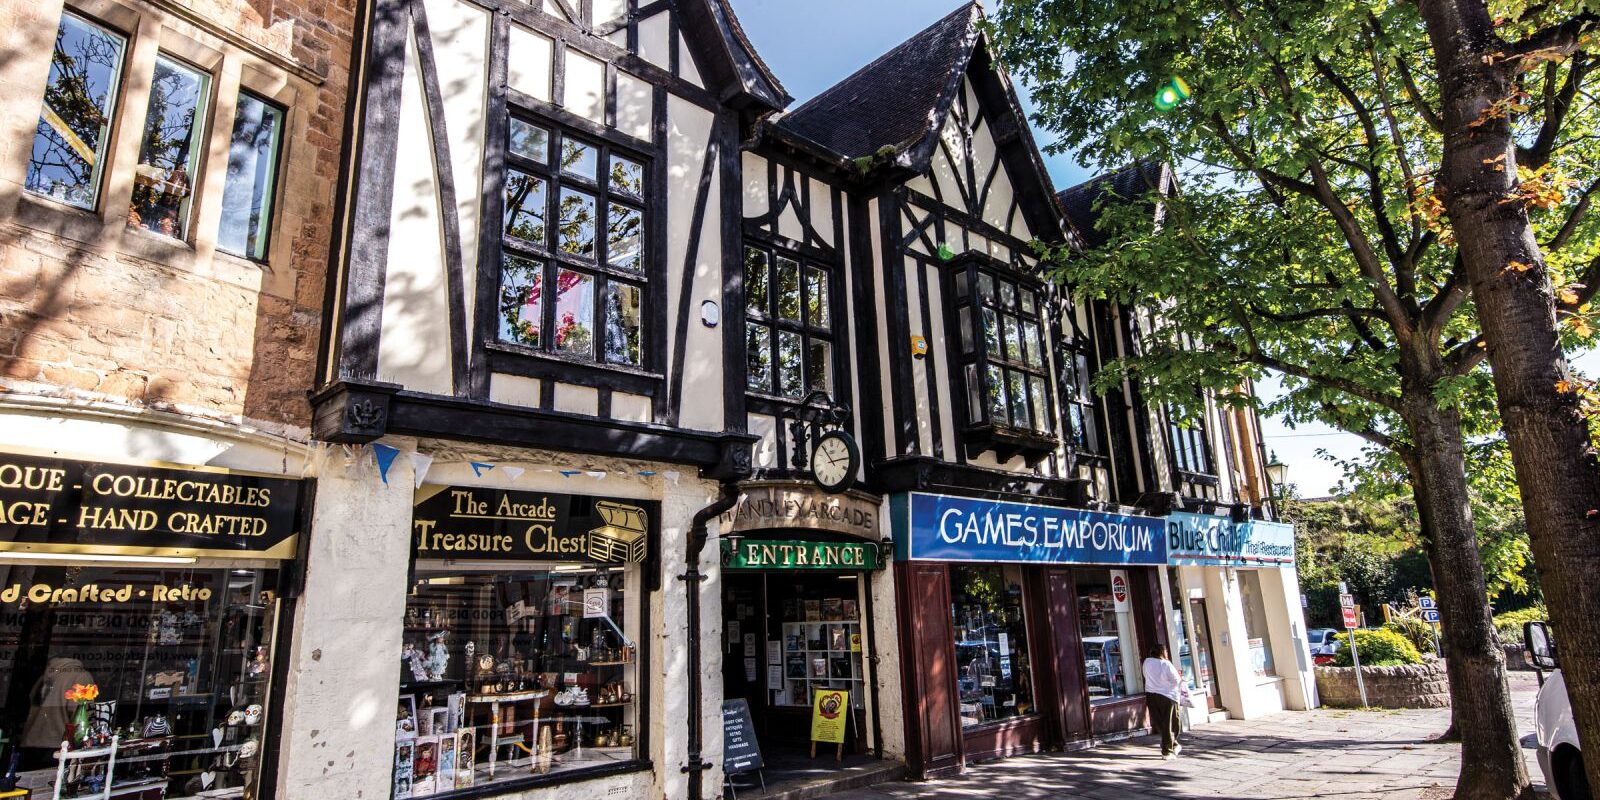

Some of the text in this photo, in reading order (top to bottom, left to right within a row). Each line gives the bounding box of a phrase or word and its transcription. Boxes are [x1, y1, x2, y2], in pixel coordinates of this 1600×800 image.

[92, 473, 271, 507] COLLECTABLES
[451, 490, 556, 519] The Arcade
[77, 506, 158, 531] HAND
[167, 511, 267, 537] CRAFTED
[808, 499, 873, 529] ARCADE
[414, 519, 587, 553] Treasure Chest
[940, 507, 1153, 553] GAMES EMPORIUM
[1169, 521, 1204, 552] Blue
[747, 544, 865, 566] ENTRANCE
[27, 584, 133, 604] Crafted
[153, 585, 212, 602] Retro
[1422, 599, 1430, 607] P
[1430, 612, 1438, 620] P
